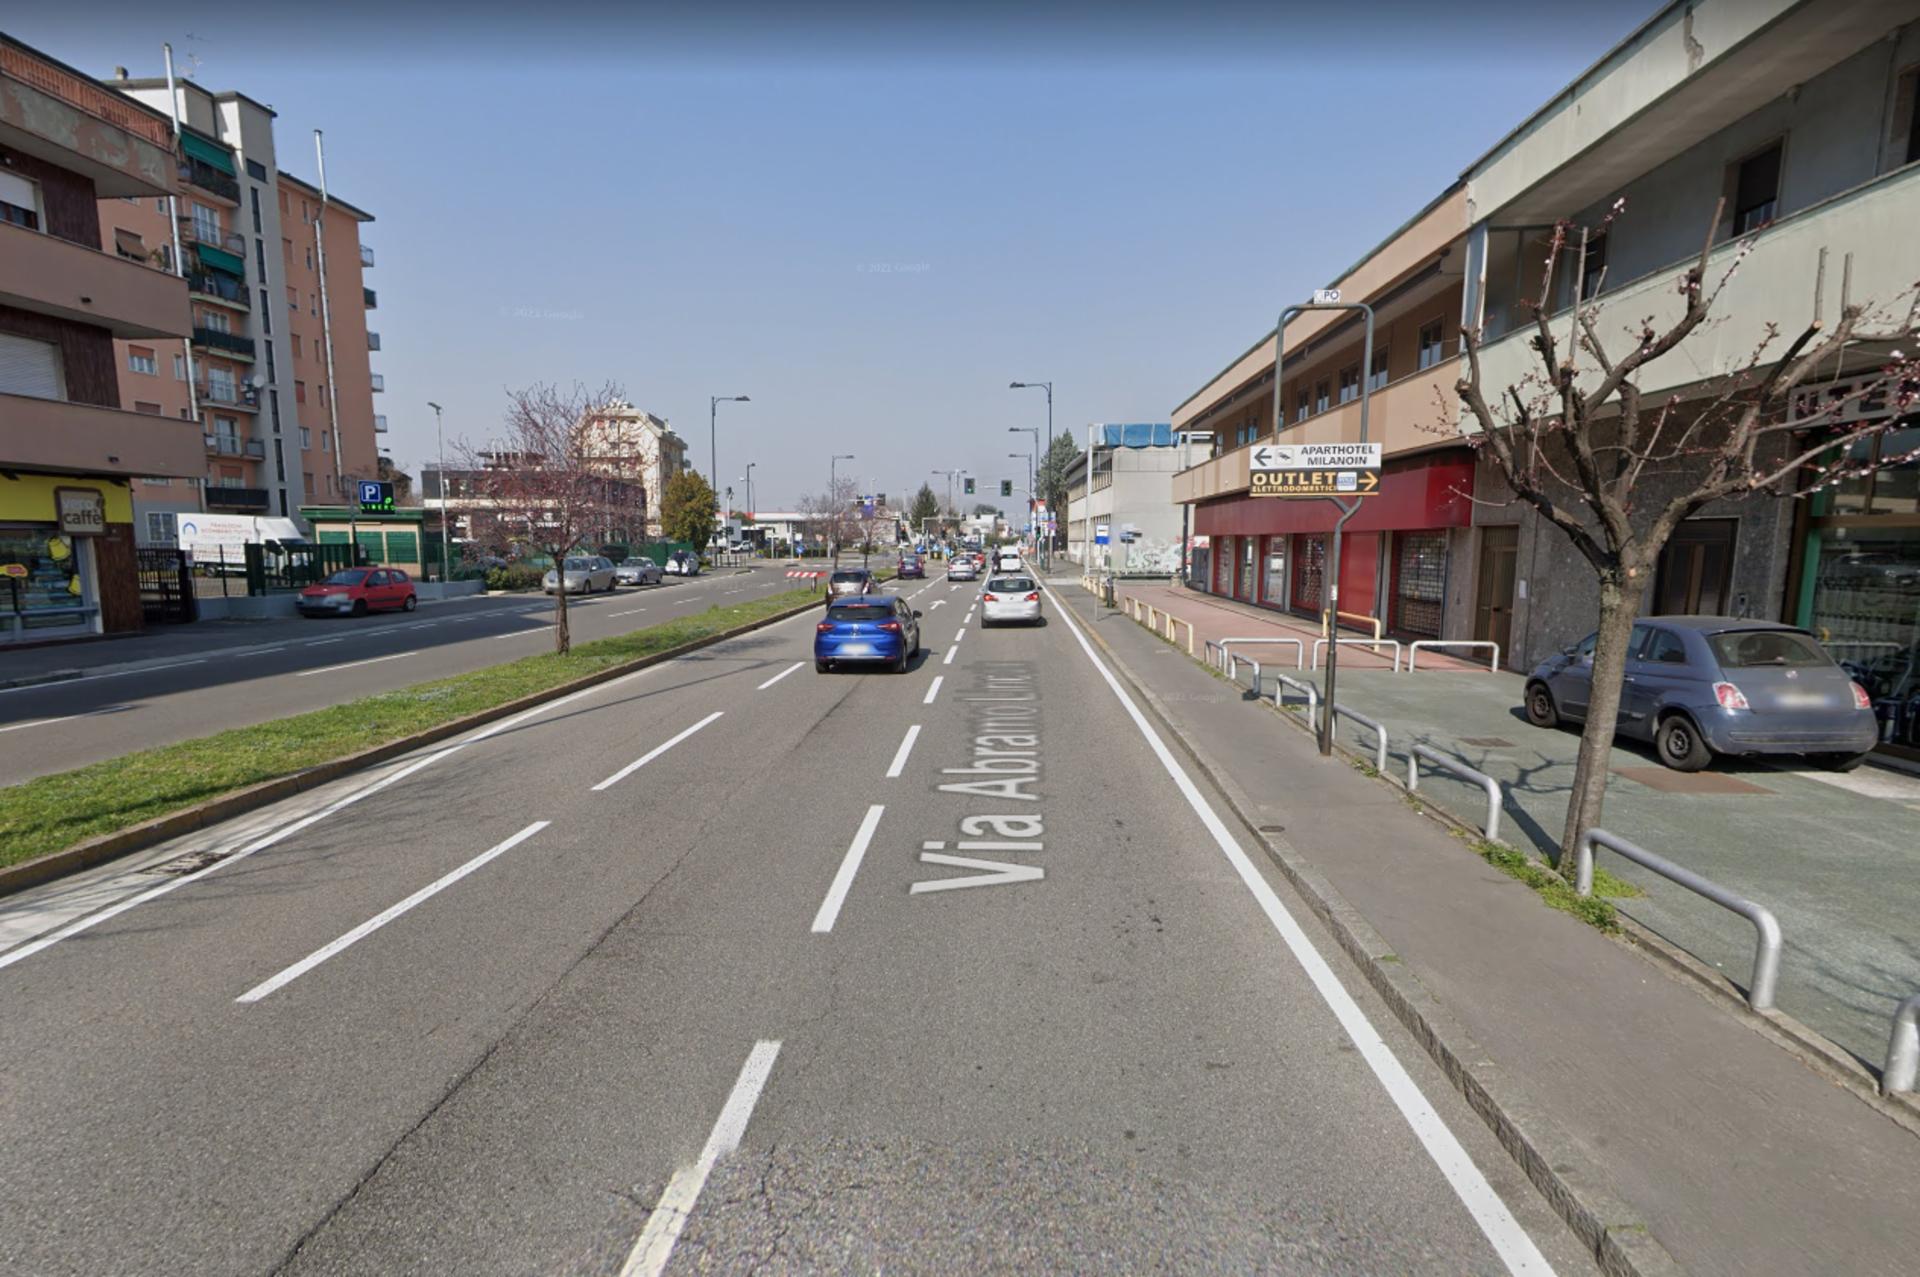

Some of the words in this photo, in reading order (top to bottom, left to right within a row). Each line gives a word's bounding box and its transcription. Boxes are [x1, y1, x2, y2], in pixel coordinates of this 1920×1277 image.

[1301, 445, 1374, 455] APARTHOTEL
[1307, 456, 1368, 466] MILANOIN
[1252, 472, 1337, 486] OUTLET
[364, 485, 376, 499] P
